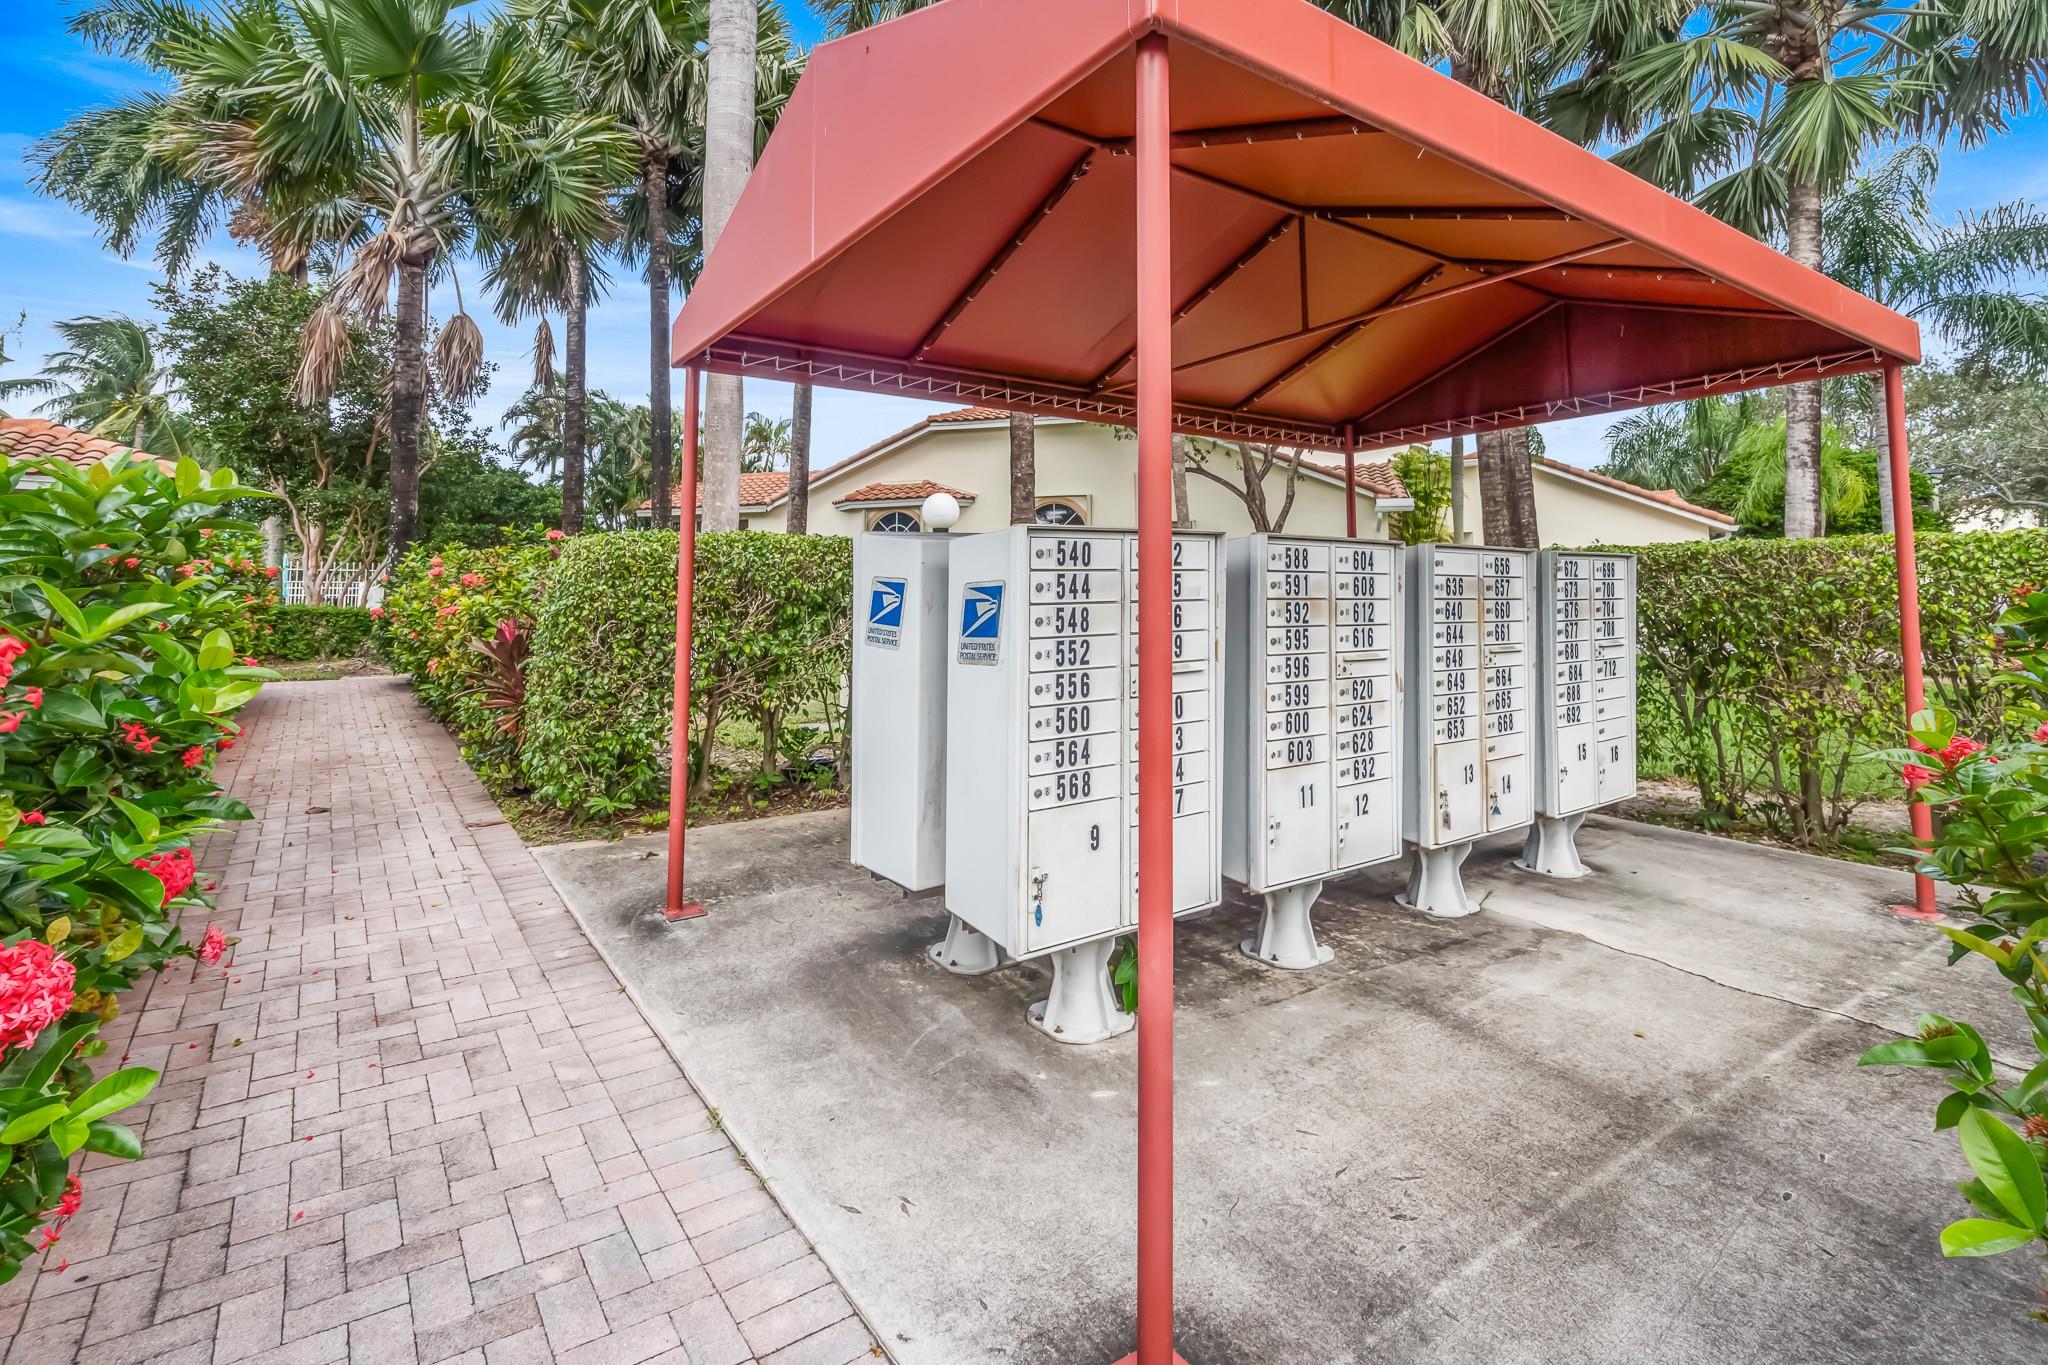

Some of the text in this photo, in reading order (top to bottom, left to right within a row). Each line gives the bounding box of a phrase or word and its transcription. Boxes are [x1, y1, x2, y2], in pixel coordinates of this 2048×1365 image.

[1056, 540, 1091, 567] 540
[1285, 547, 1309, 569] 588
[1353, 551, 1374, 571] 604
[1494, 557, 1510, 575] 656
[1056, 573, 1091, 600] 544
[1285, 574, 1308, 596] 591
[1353, 576, 1375, 596] 608
[1445, 578, 1464, 596] 636
[1494, 579, 1510, 597] 657
[1055, 607, 1089, 634] 548
[1285, 601, 1309, 624] 592
[1353, 602, 1374, 623] 612
[1445, 601, 1463, 620] 640
[1494, 601, 1510, 619] 660
[867, 636, 898, 646] POSTAL SERVICE
[868, 628, 882, 636] UNITED
[1285, 628, 1309, 651] 595
[1353, 627, 1374, 648] 616
[1446, 625, 1464, 644] 644
[1495, 623, 1510, 641] 661
[960, 652, 997, 661] POSTAL SERVICE
[961, 642, 995, 651] UNITED STATES
[1055, 639, 1090, 667] 552
[1285, 655, 1310, 679] 596
[1445, 649, 1463, 668] 648
[1055, 672, 1091, 700] 556
[1447, 672, 1465, 692] 649
[1495, 667, 1512, 687] 664
[1285, 684, 1309, 707] 599
[1352, 679, 1373, 700] 620
[1447, 696, 1465, 716] 652
[1495, 691, 1512, 710] 665
[1055, 705, 1090, 734] 560
[1285, 711, 1309, 734] 600
[1352, 705, 1373, 727] 624
[1497, 713, 1514, 733] 668
[1447, 719, 1465, 739] 653
[1288, 740, 1313, 763] 603
[1352, 730, 1374, 754] 628
[1055, 738, 1091, 768] 564
[1353, 757, 1375, 780] 632
[1464, 764, 1474, 785] 13
[1056, 771, 1091, 801] 568
[1502, 774, 1511, 794] 14
[1300, 783, 1314, 808] 11
[1355, 793, 1369, 816] 12
[1090, 824, 1100, 851] 9
